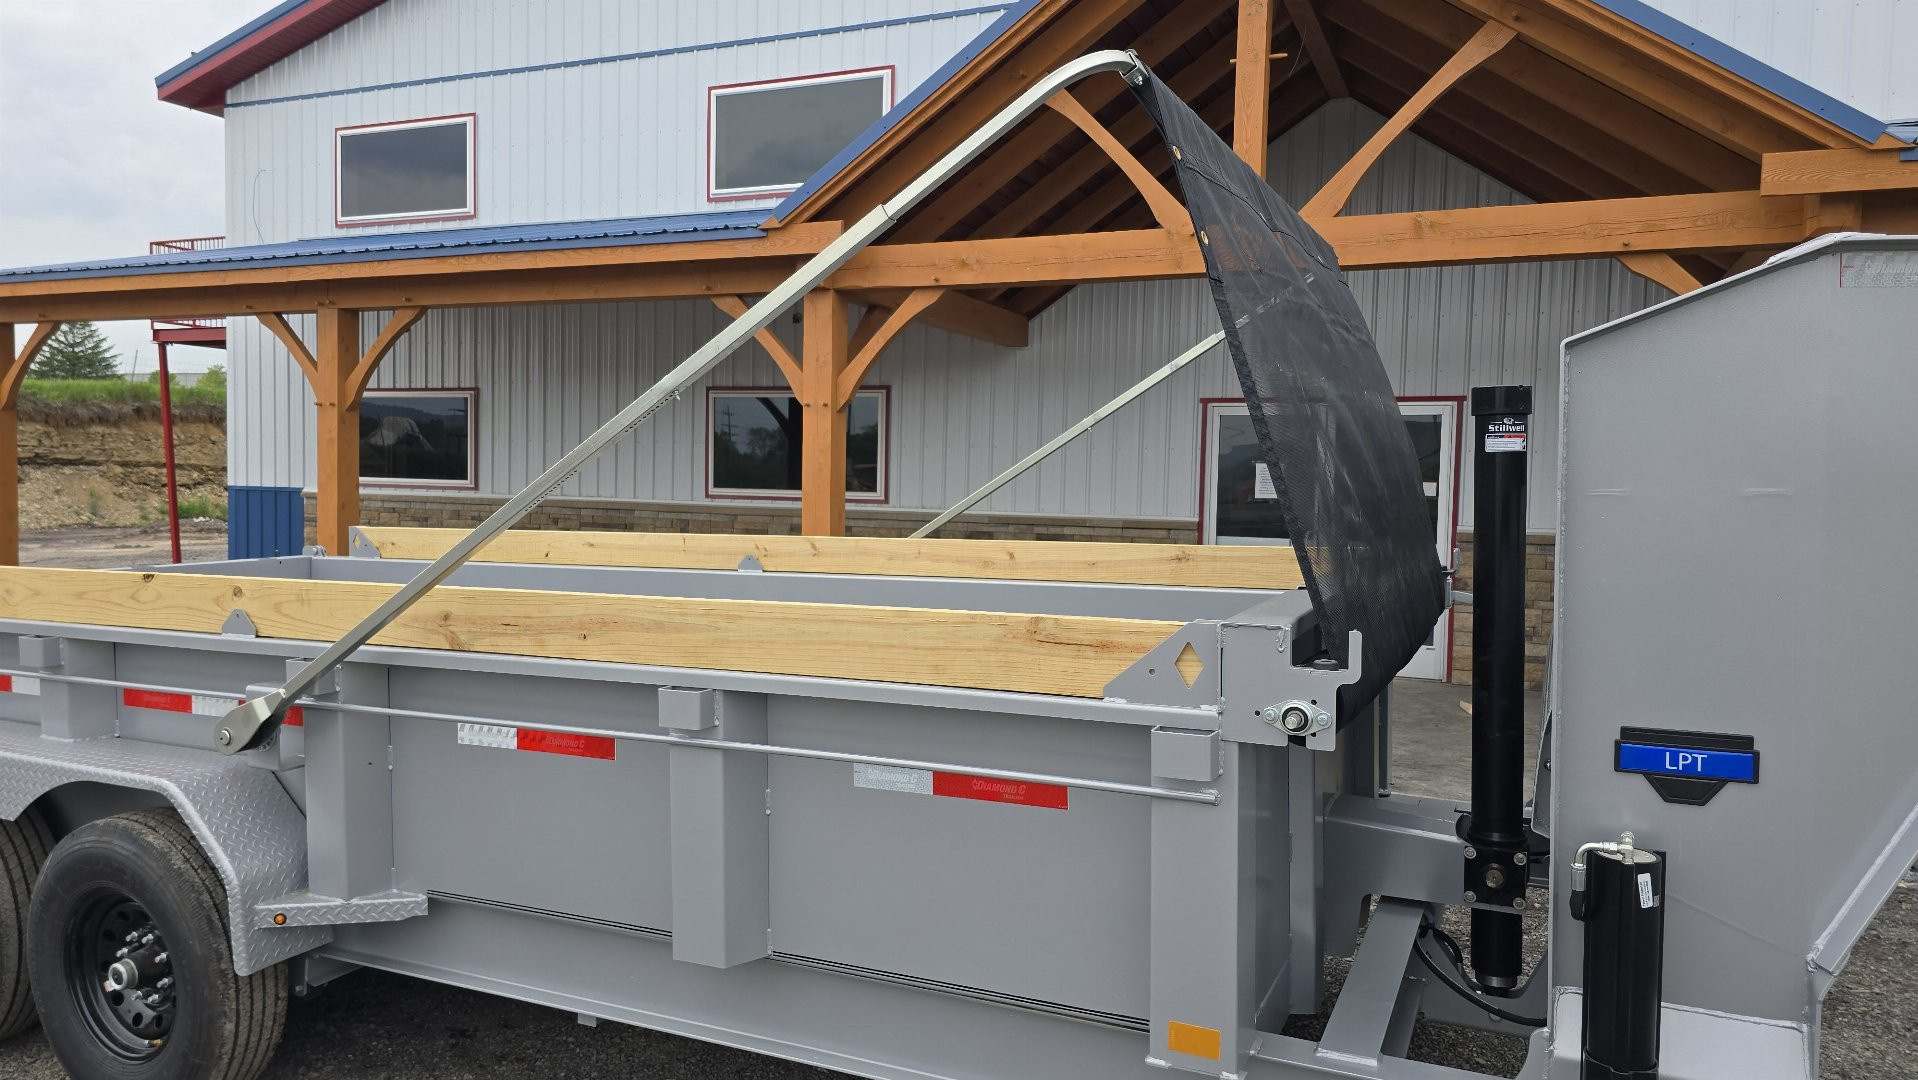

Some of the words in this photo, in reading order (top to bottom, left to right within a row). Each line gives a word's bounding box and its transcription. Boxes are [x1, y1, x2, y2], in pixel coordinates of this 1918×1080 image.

[1488, 424, 1525, 432] Stillwell
[1665, 751, 1708, 772] LPT
[977, 780, 1017, 794] DIAMOND
[1018, 784, 1027, 795] C
